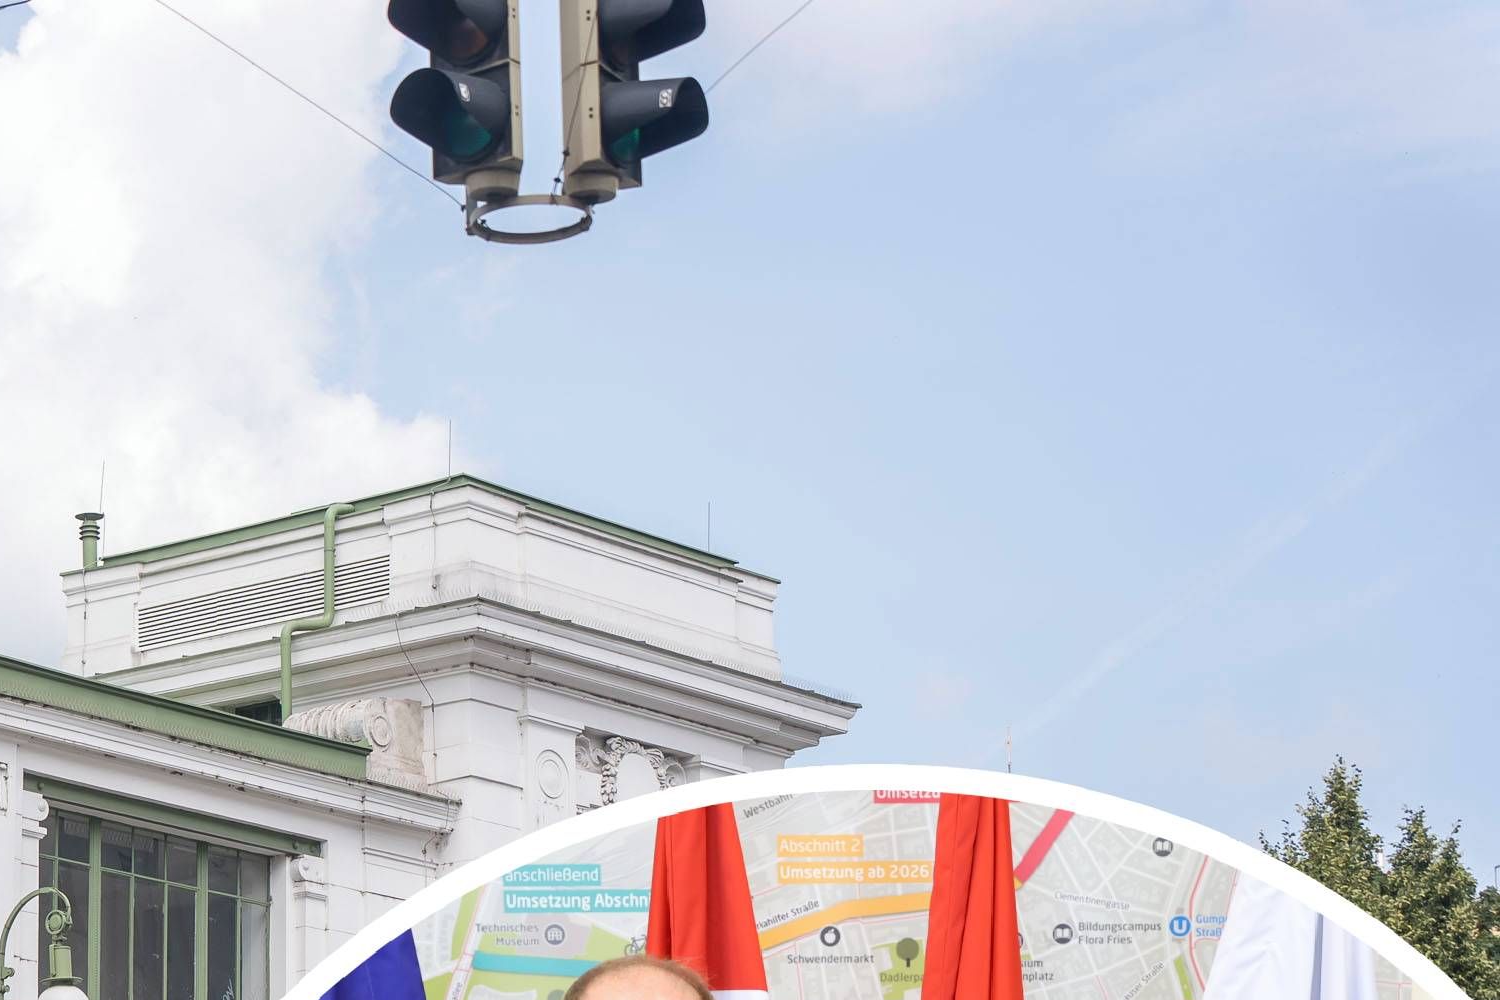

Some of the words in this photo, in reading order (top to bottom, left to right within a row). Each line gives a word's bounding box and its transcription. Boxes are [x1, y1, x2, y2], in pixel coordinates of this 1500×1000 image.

[780, 838, 847, 853] Abschnitt
[850, 839, 861, 853] 2
[505, 867, 599, 882] anschließend
[780, 865, 863, 881] Umsetzung
[868, 866, 885, 879] ab
[889, 864, 930, 878] 2026
[506, 893, 591, 911] Umsetzung
[790, 900, 820, 916] Straße
[475, 923, 540, 933] Technisches
[1078, 921, 1161, 933] Bildungscampus
[496, 937, 540, 946] Museum
[1078, 935, 1104, 944] Flora
[1106, 935, 1133, 944] Fries
[787, 954, 875, 964] Schwendermarkt
